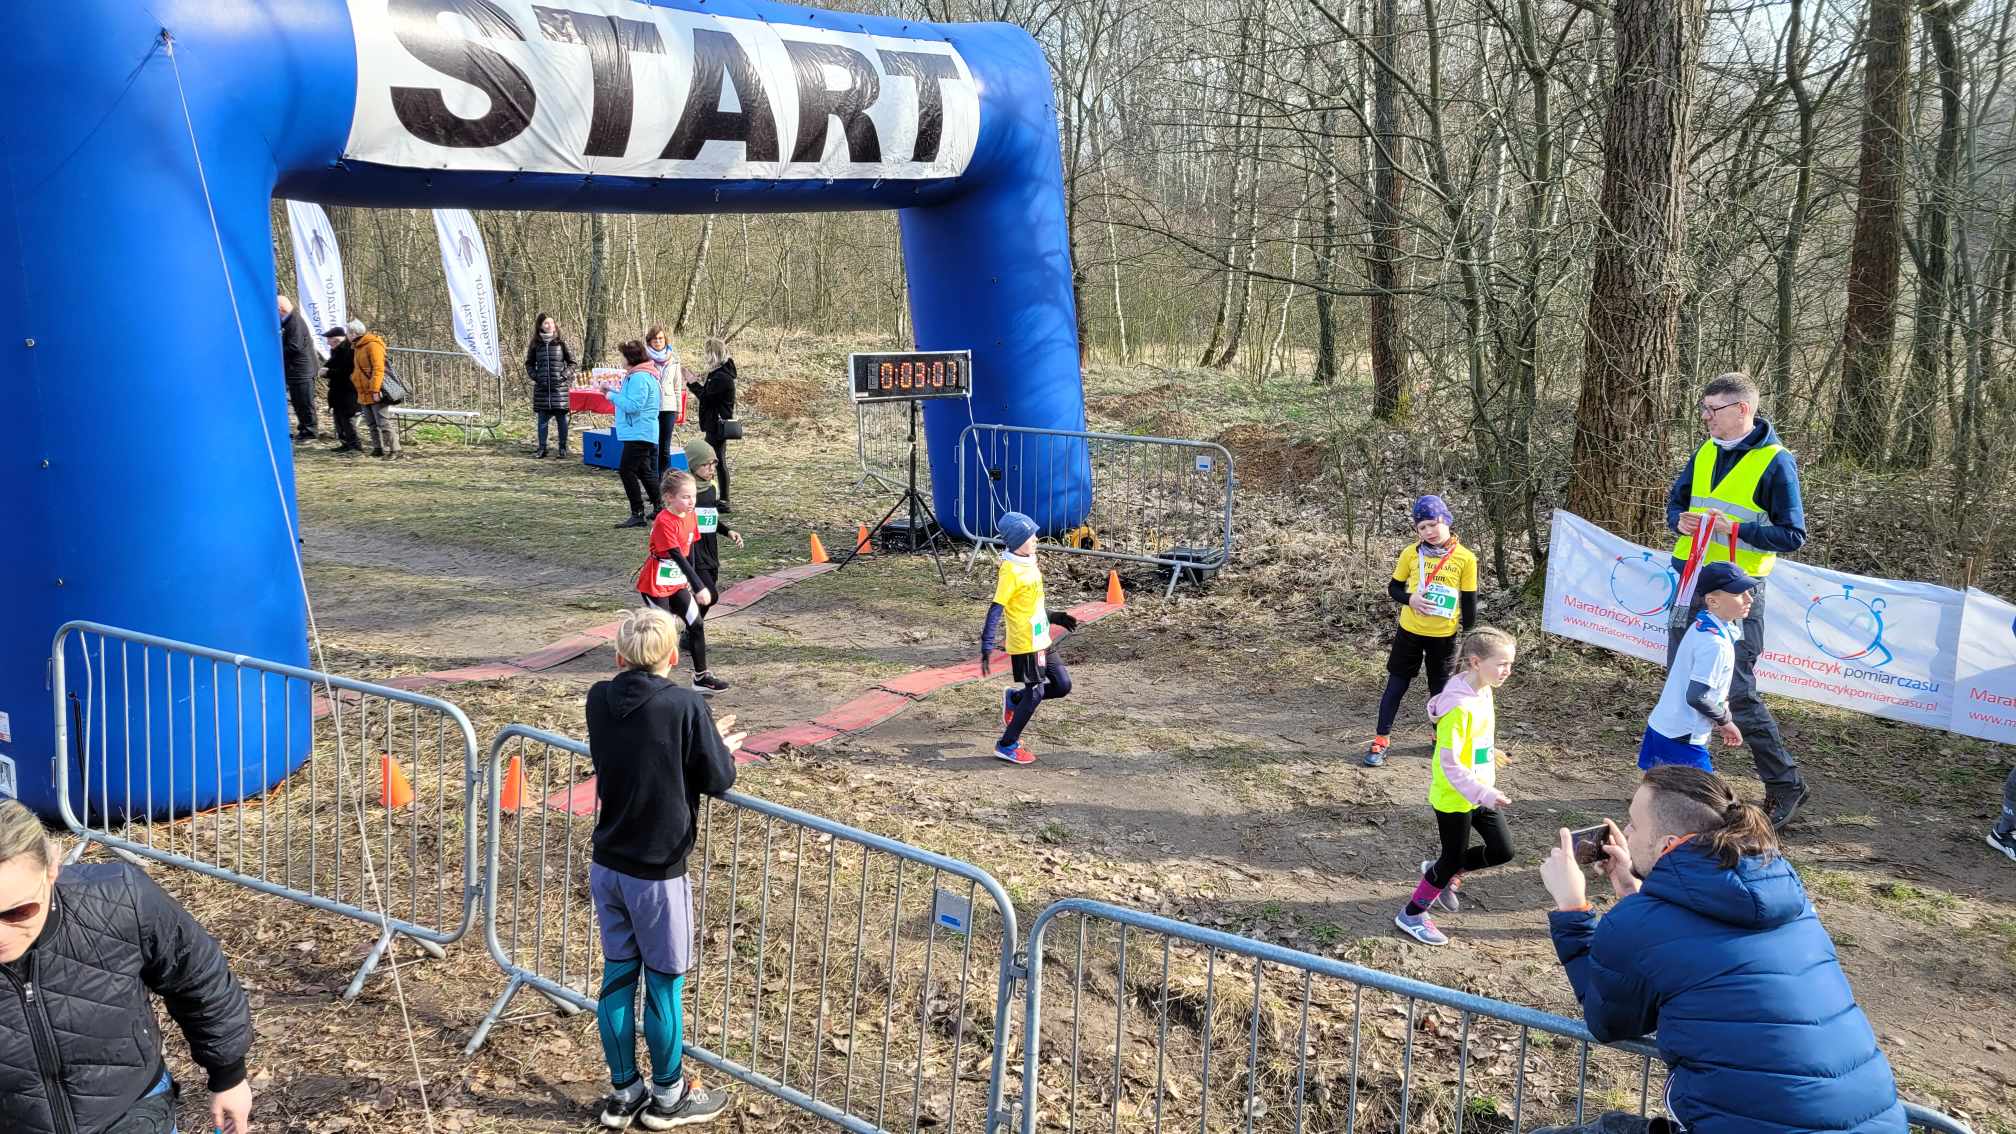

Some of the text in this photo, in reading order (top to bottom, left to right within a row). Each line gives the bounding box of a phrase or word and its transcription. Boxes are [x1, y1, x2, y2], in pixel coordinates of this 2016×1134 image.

[391, 0, 961, 163] START
[593, 440, 602, 458] 2
[704, 516, 714, 526] 73
[1431, 594, 1446, 607] 70
[1564, 595, 1640, 626] Maratończyk
[1844, 667, 1939, 693] pomiarczasu
